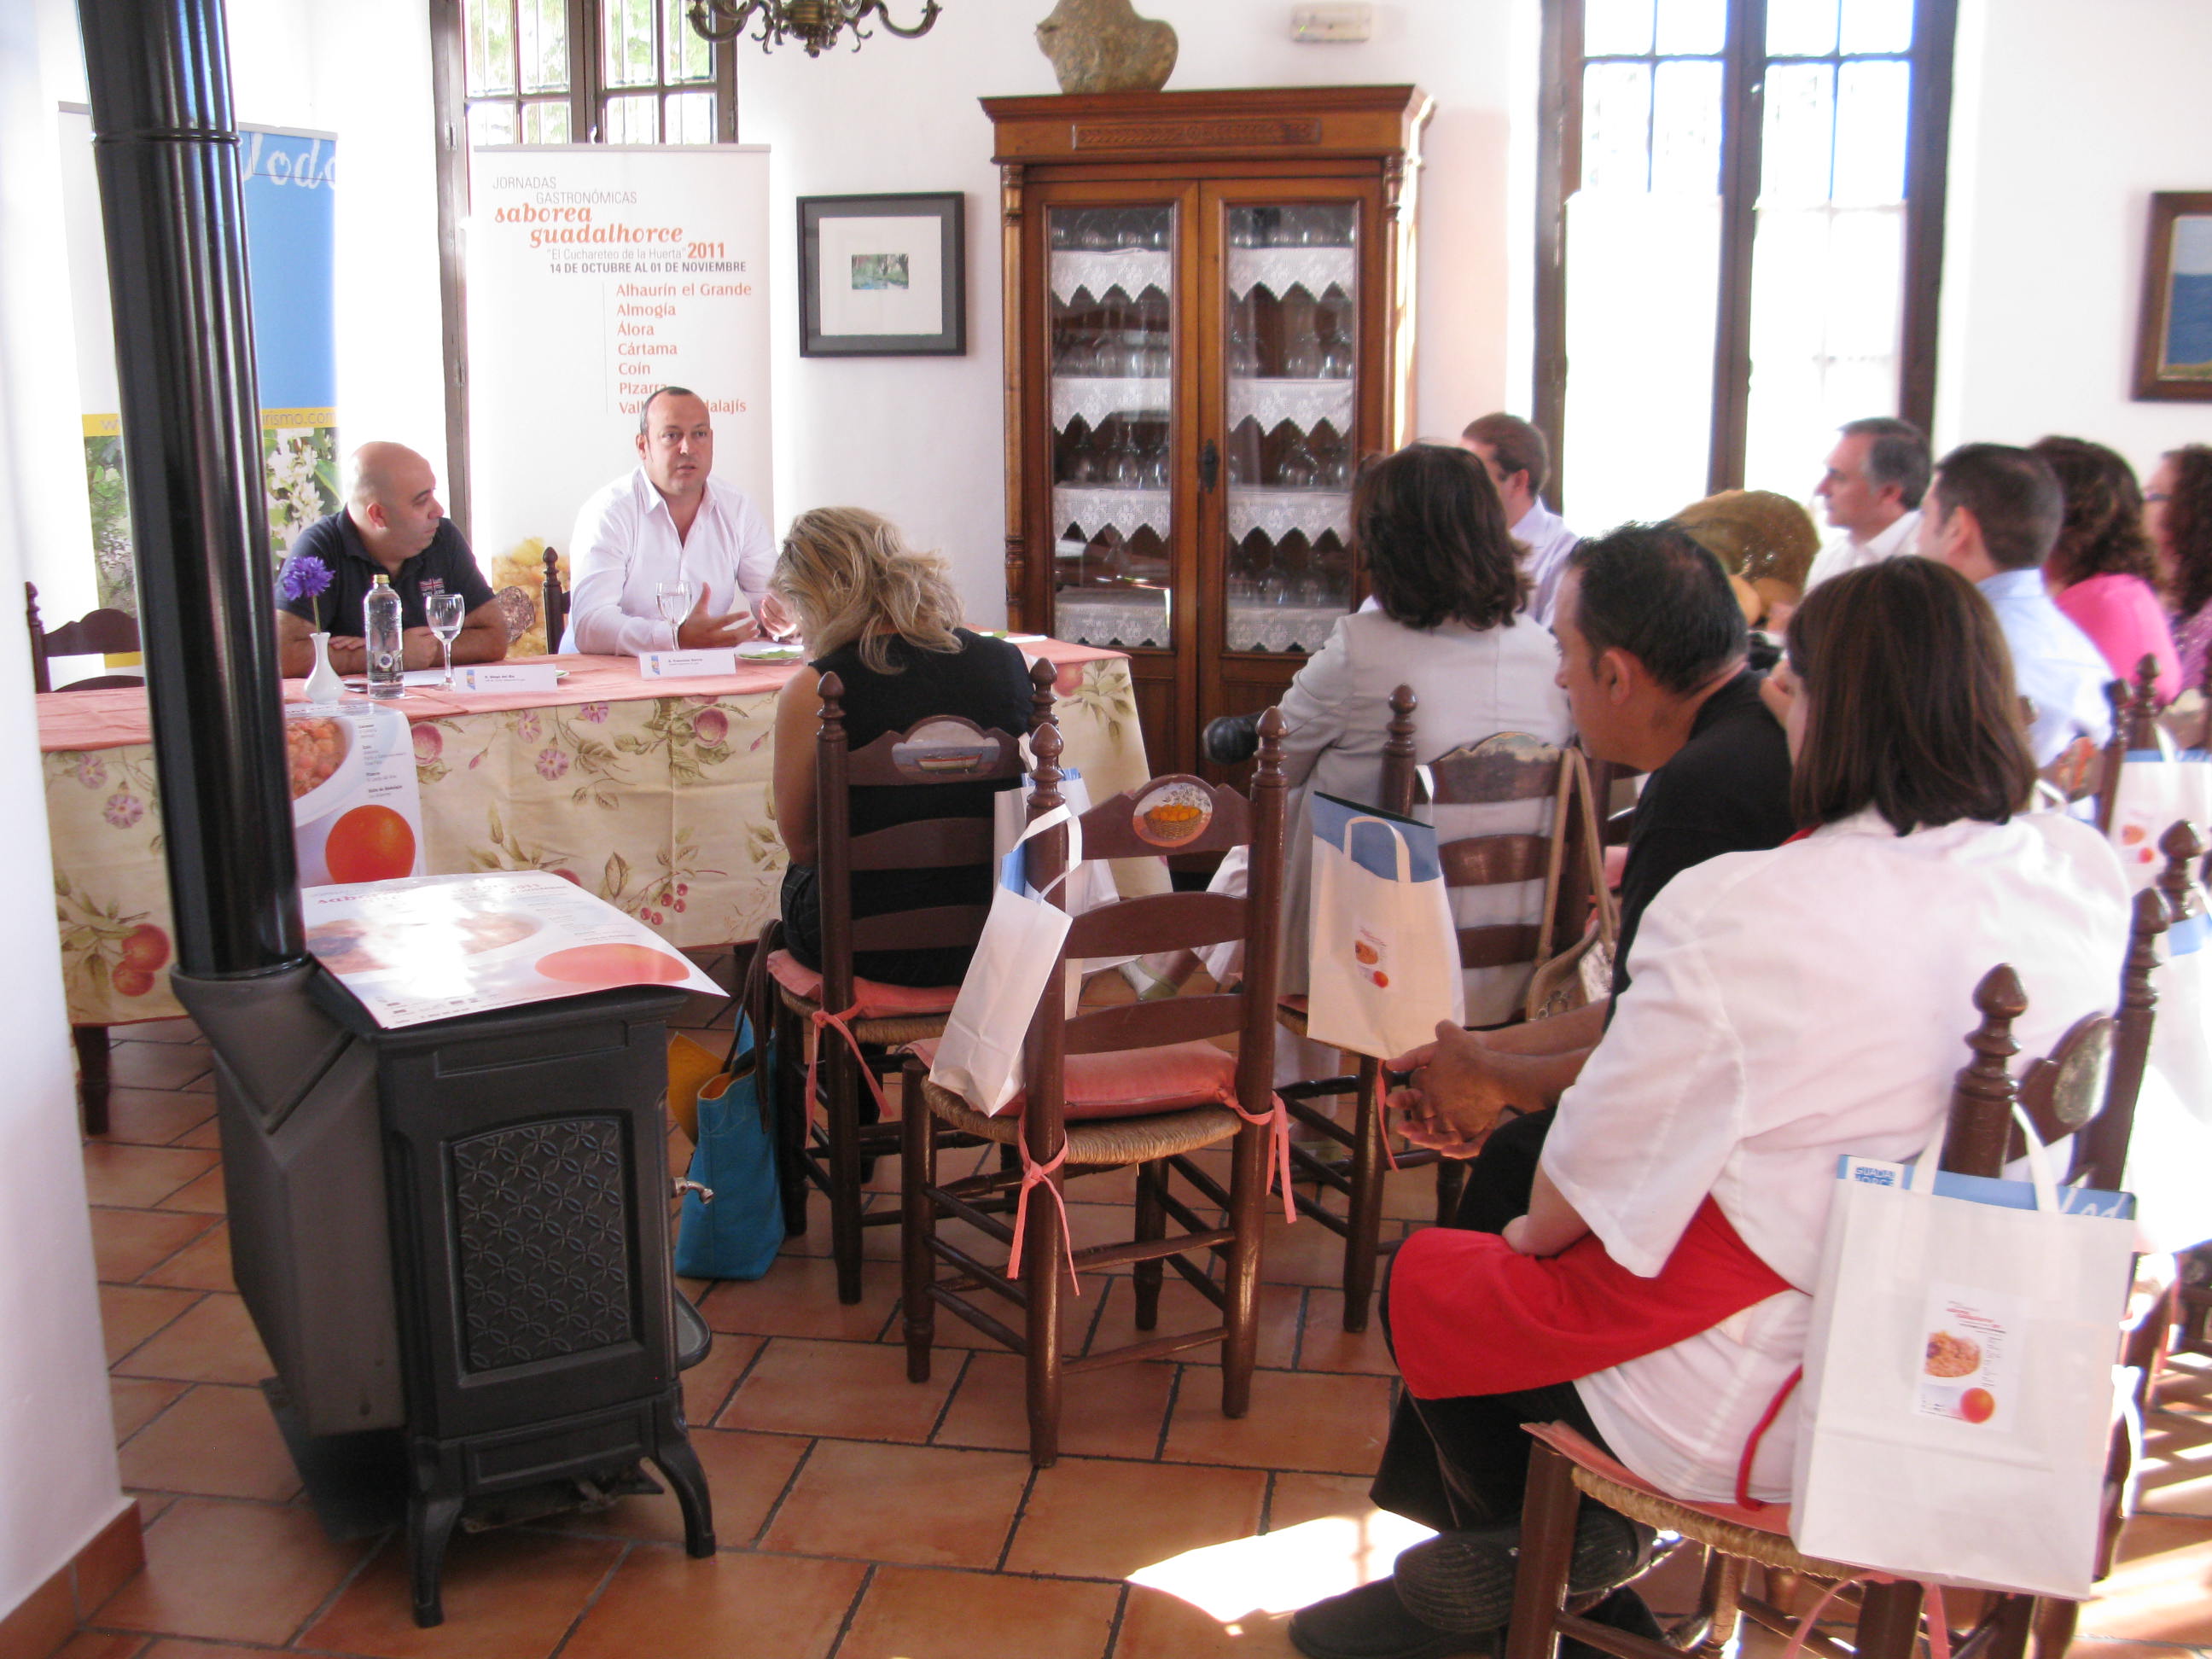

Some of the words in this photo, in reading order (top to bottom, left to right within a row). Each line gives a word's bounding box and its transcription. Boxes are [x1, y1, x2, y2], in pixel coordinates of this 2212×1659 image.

[492, 176, 557, 189] JORNADAS
[535, 189, 638, 205] GASTRONÓMICAS
[494, 202, 593, 224] saborea
[529, 223, 684, 248] guadalhorce
[622, 247, 634, 259] de
[637, 247, 646, 259] la
[687, 242, 725, 259] 2011
[550, 263, 562, 274] 14
[564, 263, 579, 273] DE
[581, 262, 632, 273] OCTUBRE
[634, 262, 648, 273] AL
[650, 262, 661, 273] 01
[665, 262, 679, 272] DE
[682, 261, 747, 272] NOVIEMBRE
[615, 282, 677, 297] Alhaurín
[682, 283, 695, 296] el
[700, 282, 752, 296] Grande
[616, 303, 677, 318] Almogía
[617, 321, 655, 336] Álora
[618, 342, 678, 356] Cártama
[619, 362, 651, 375] Coín
[619, 401, 644, 414] Vall
